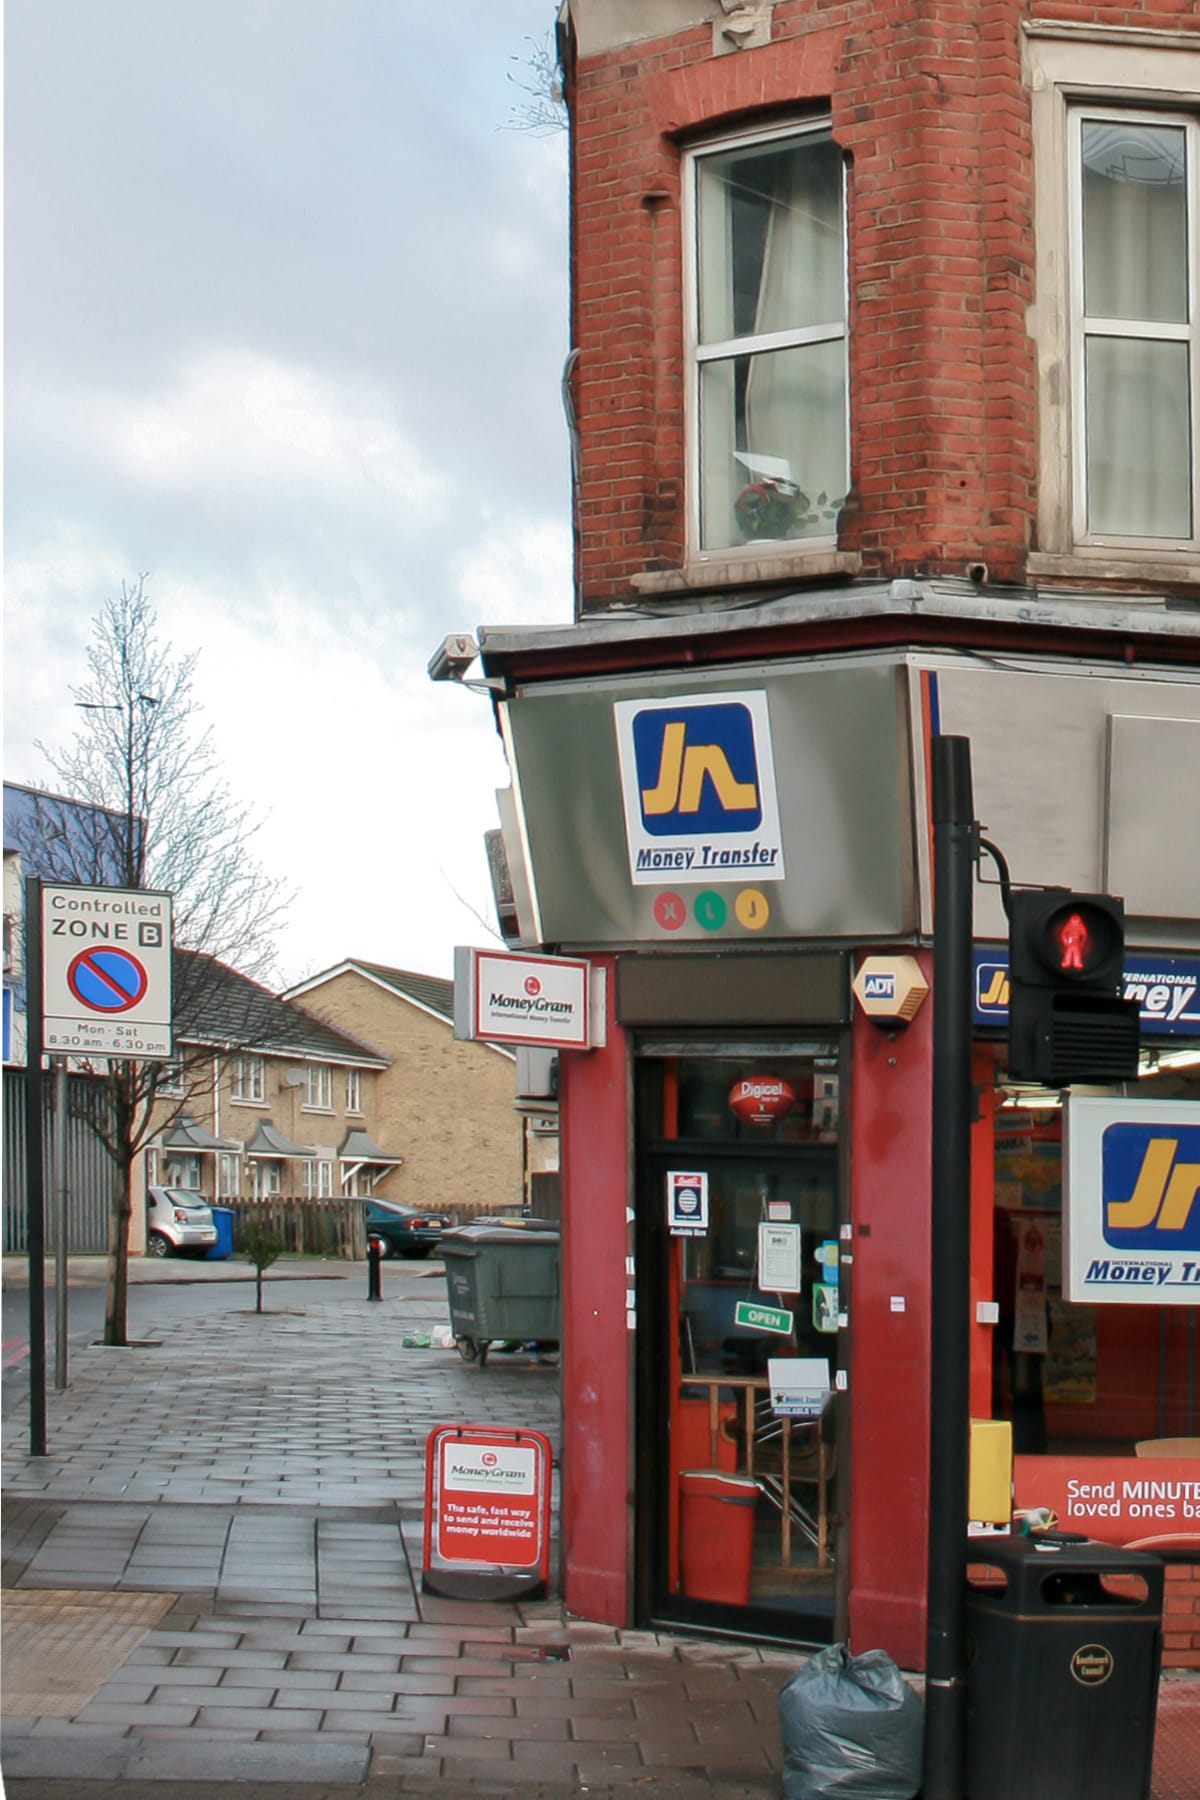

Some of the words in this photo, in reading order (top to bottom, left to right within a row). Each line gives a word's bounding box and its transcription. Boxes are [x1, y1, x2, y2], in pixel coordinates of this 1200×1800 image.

[637, 849, 695, 870] Money
[702, 842, 778, 865] Transfer
[52, 895, 161, 917] Controlled
[52, 919, 129, 940] ZONE
[145, 926, 160, 943] B
[865, 979, 894, 994] ADT
[489, 993, 572, 1013] MoneyGram
[78, 1024, 104, 1034] Mon
[116, 1026, 137, 1036] Sat
[50, 1035, 80, 1045] 8.30
[84, 1038, 101, 1046] am
[113, 1039, 143, 1049] 6.30
[147, 1042, 165, 1052] pm
[741, 1082, 782, 1098] Digicel
[1086, 1260, 1172, 1285] Money
[748, 1310, 780, 1327] OPEN
[451, 1464, 526, 1479] MoneyGram
[1067, 1480, 1115, 1499] Send
[447, 1503, 465, 1513] The
[466, 1505, 489, 1515] safe,
[490, 1506, 508, 1516] fast
[511, 1509, 531, 1519] way
[1067, 1498, 1120, 1517] loved
[1128, 1501, 1176, 1518] ones
[443, 1514, 454, 1522] to
[456, 1516, 478, 1524] send
[480, 1517, 499, 1525] and
[500, 1519, 535, 1528] receive
[446, 1526, 479, 1536] money
[481, 1528, 532, 1538] worldwide
